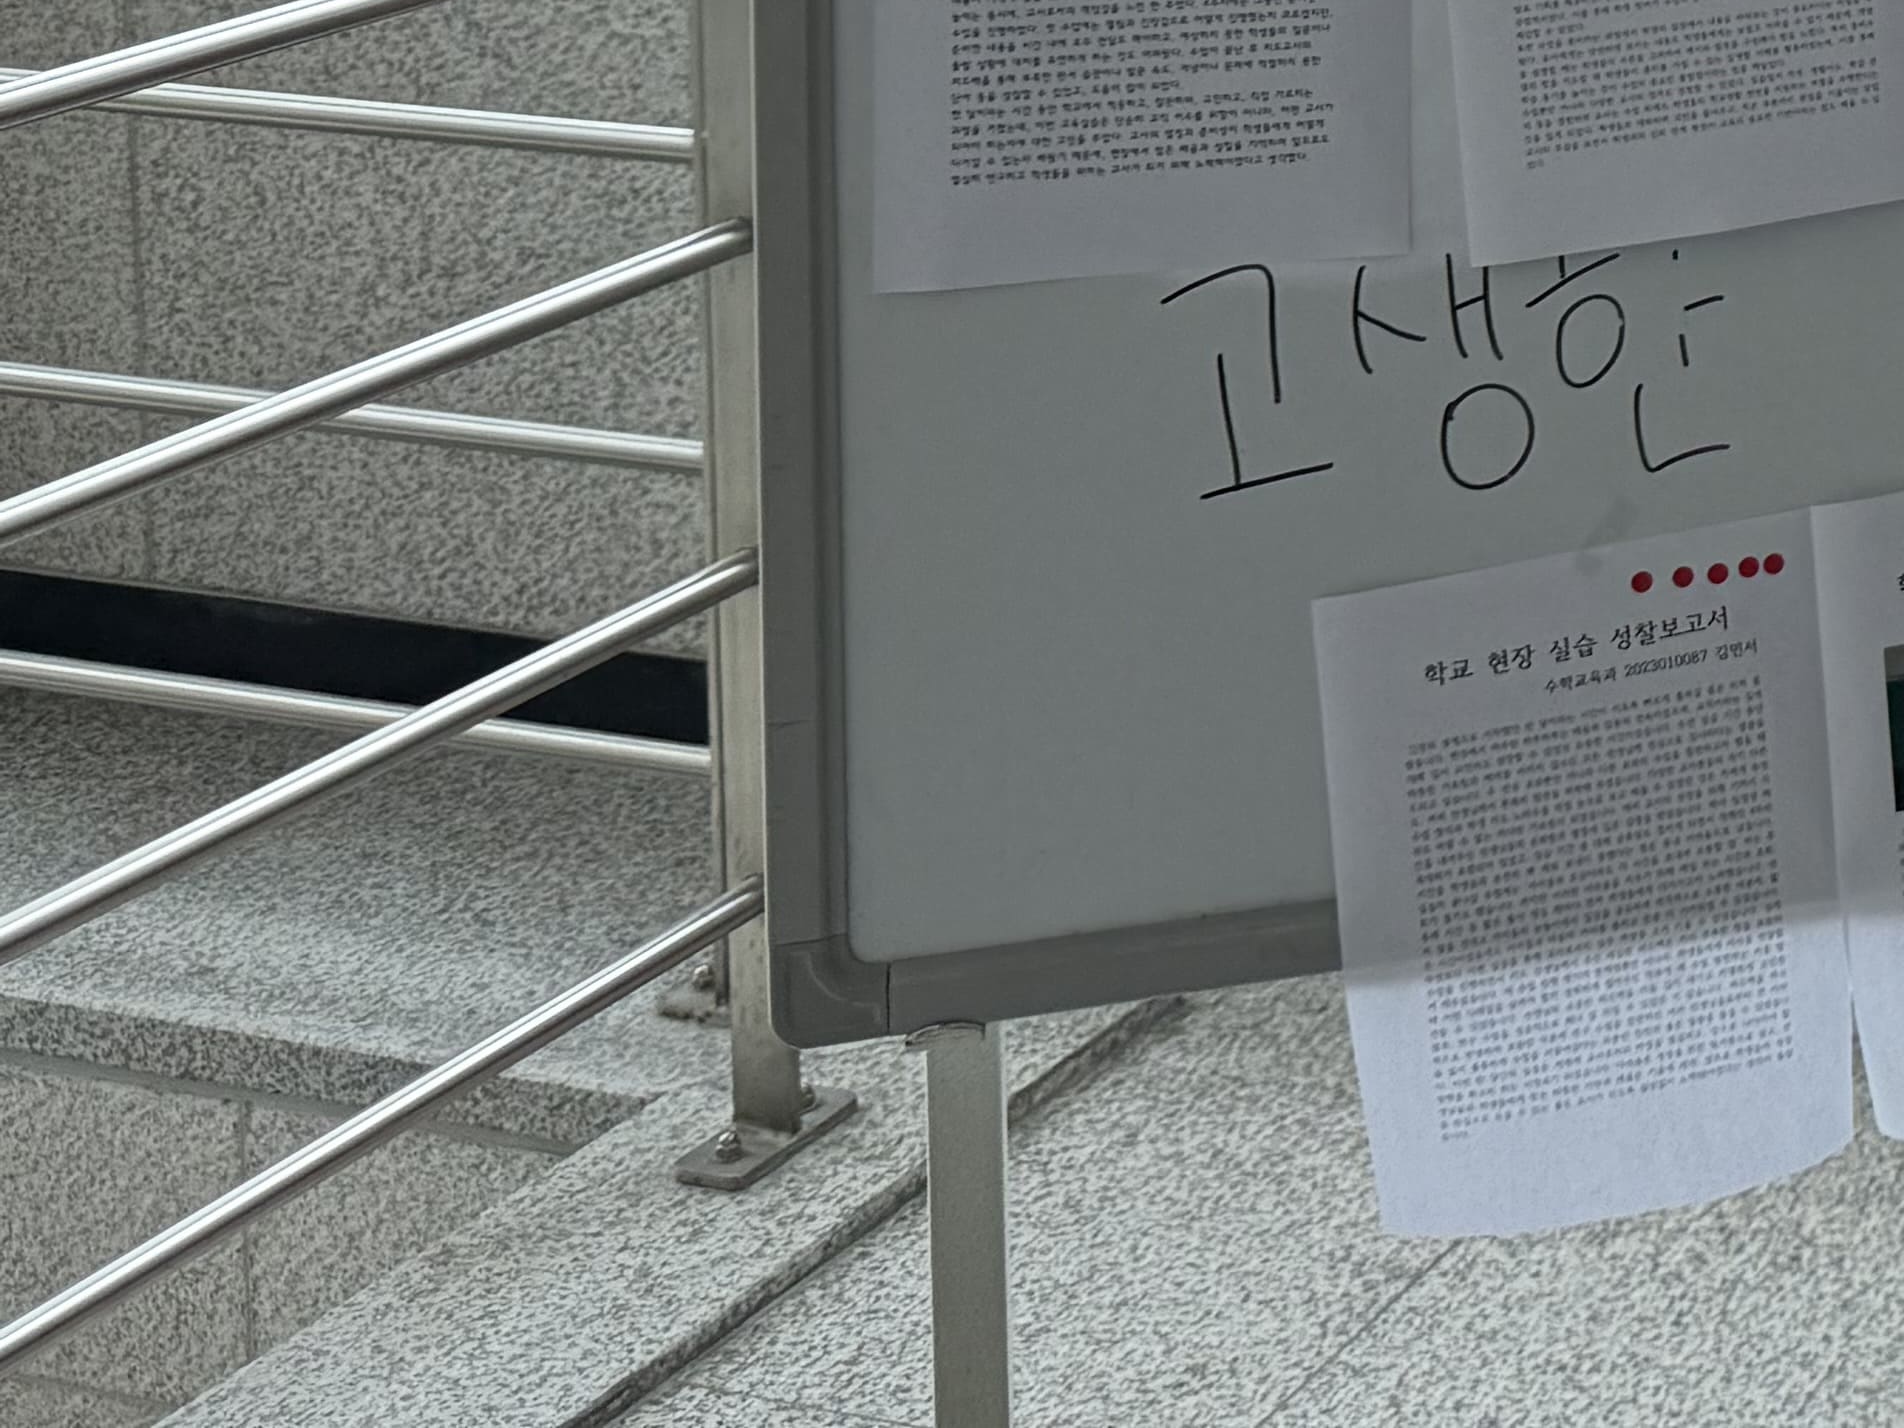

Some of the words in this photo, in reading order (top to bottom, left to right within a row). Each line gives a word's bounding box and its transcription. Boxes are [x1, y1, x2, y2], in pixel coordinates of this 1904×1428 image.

[1162, 246, 1730, 501] 고생한
[1425, 659, 1473, 685] 학교
[1488, 644, 1534, 674] 현장
[1549, 634, 1597, 662] 실습
[1610, 607, 1727, 649] 성찰보고서
